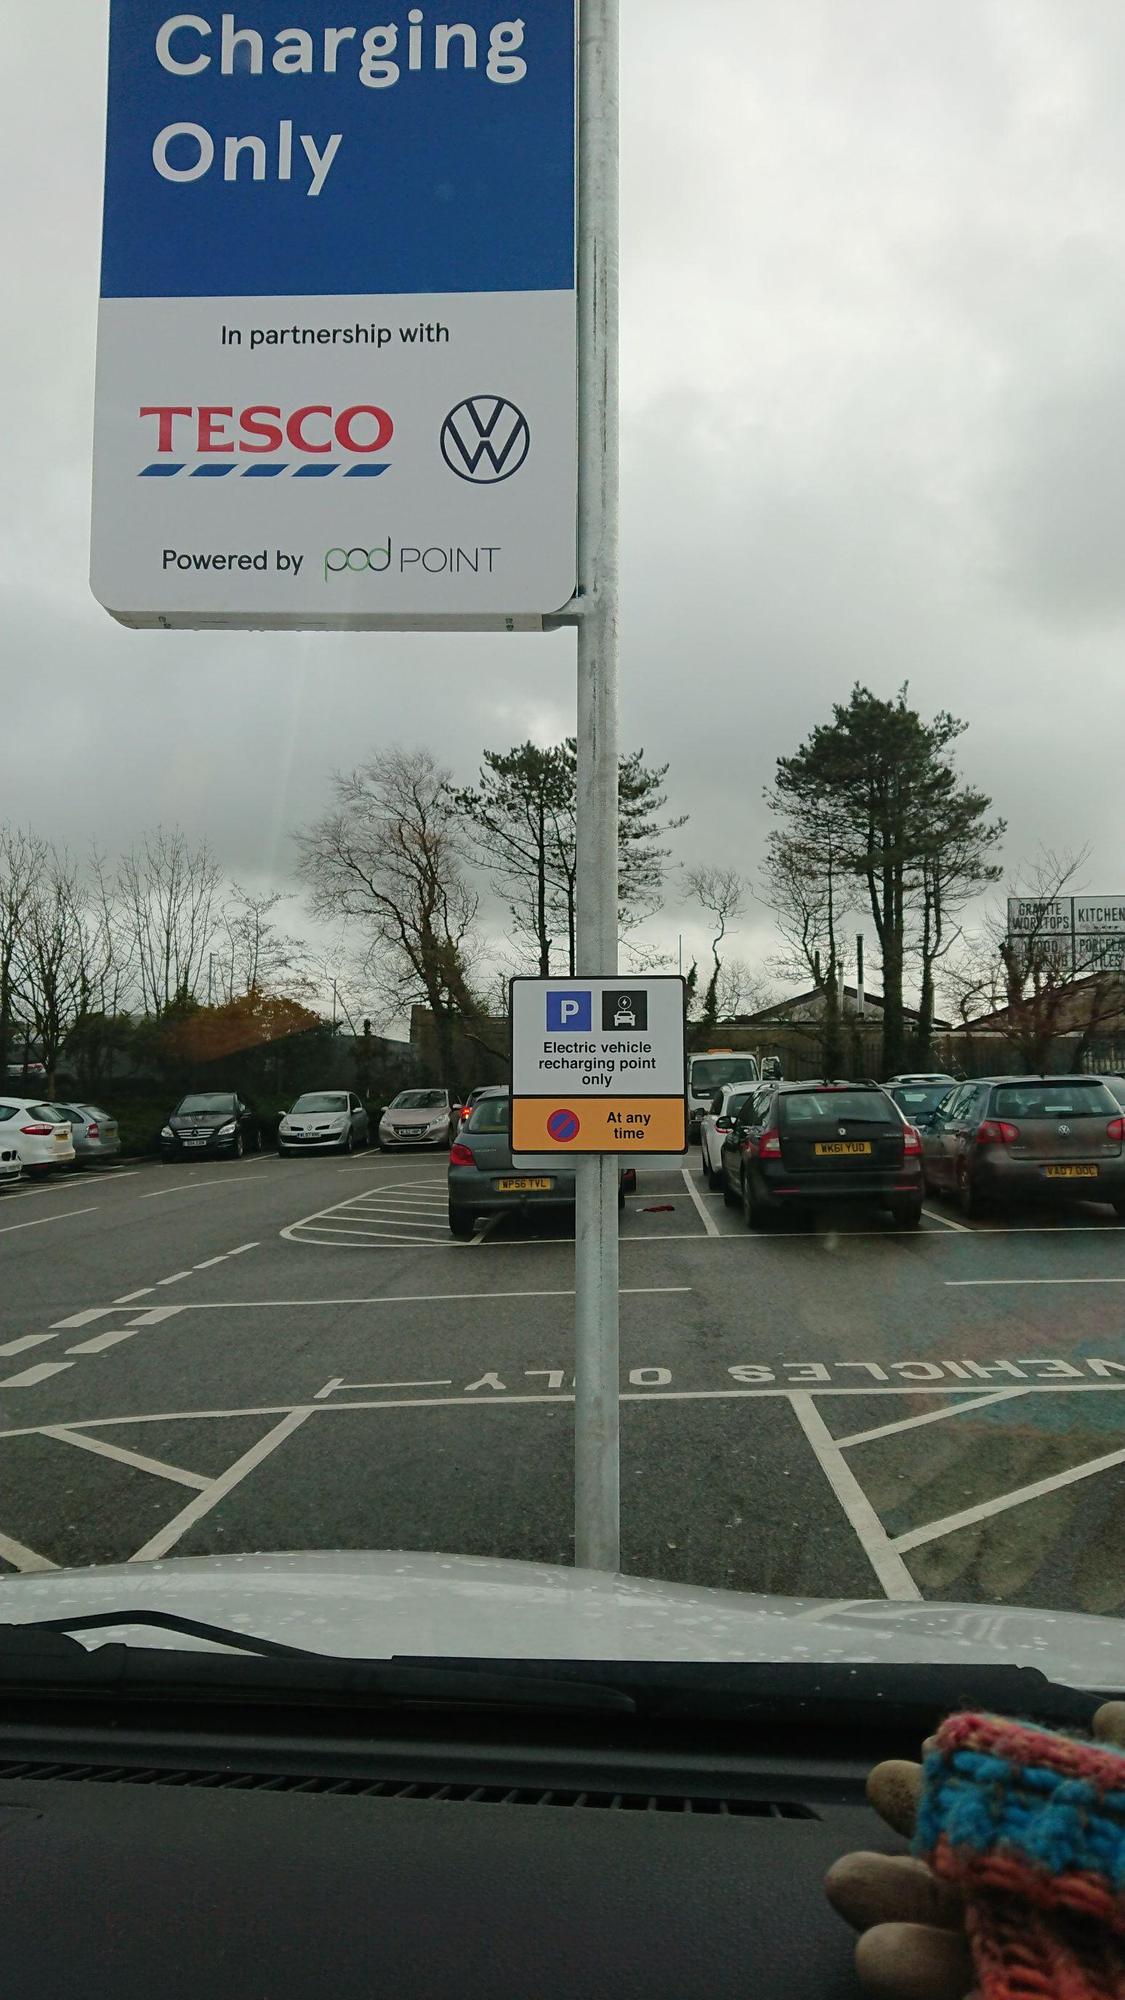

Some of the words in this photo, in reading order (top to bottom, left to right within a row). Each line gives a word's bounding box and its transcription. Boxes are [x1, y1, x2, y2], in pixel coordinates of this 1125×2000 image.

[155, 8, 528, 88] Charging
[152, 120, 343, 196] Only
[221, 325, 242, 345] In
[250, 323, 392, 350] partnership
[399, 323, 450, 343] with
[139, 405, 394, 453] TESCO
[162, 549, 268, 571] Powered
[276, 549, 304, 576] by
[324, 536, 393, 582] pod
[400, 547, 502, 573] POINT
[1012, 917, 1070, 929] WORTOPS
[560, 1000, 579, 1024] P
[543, 1041, 597, 1054] Electric
[600, 1041, 652, 1054] vehicle
[538, 1057, 615, 1072] recharging
[619, 1057, 657, 1072] point
[581, 1073, 613, 1088] only
[606, 1111, 623, 1124] At
[626, 1113, 652, 1127] any
[613, 1128, 645, 1140] time
[464, 1367, 673, 1391] OLY
